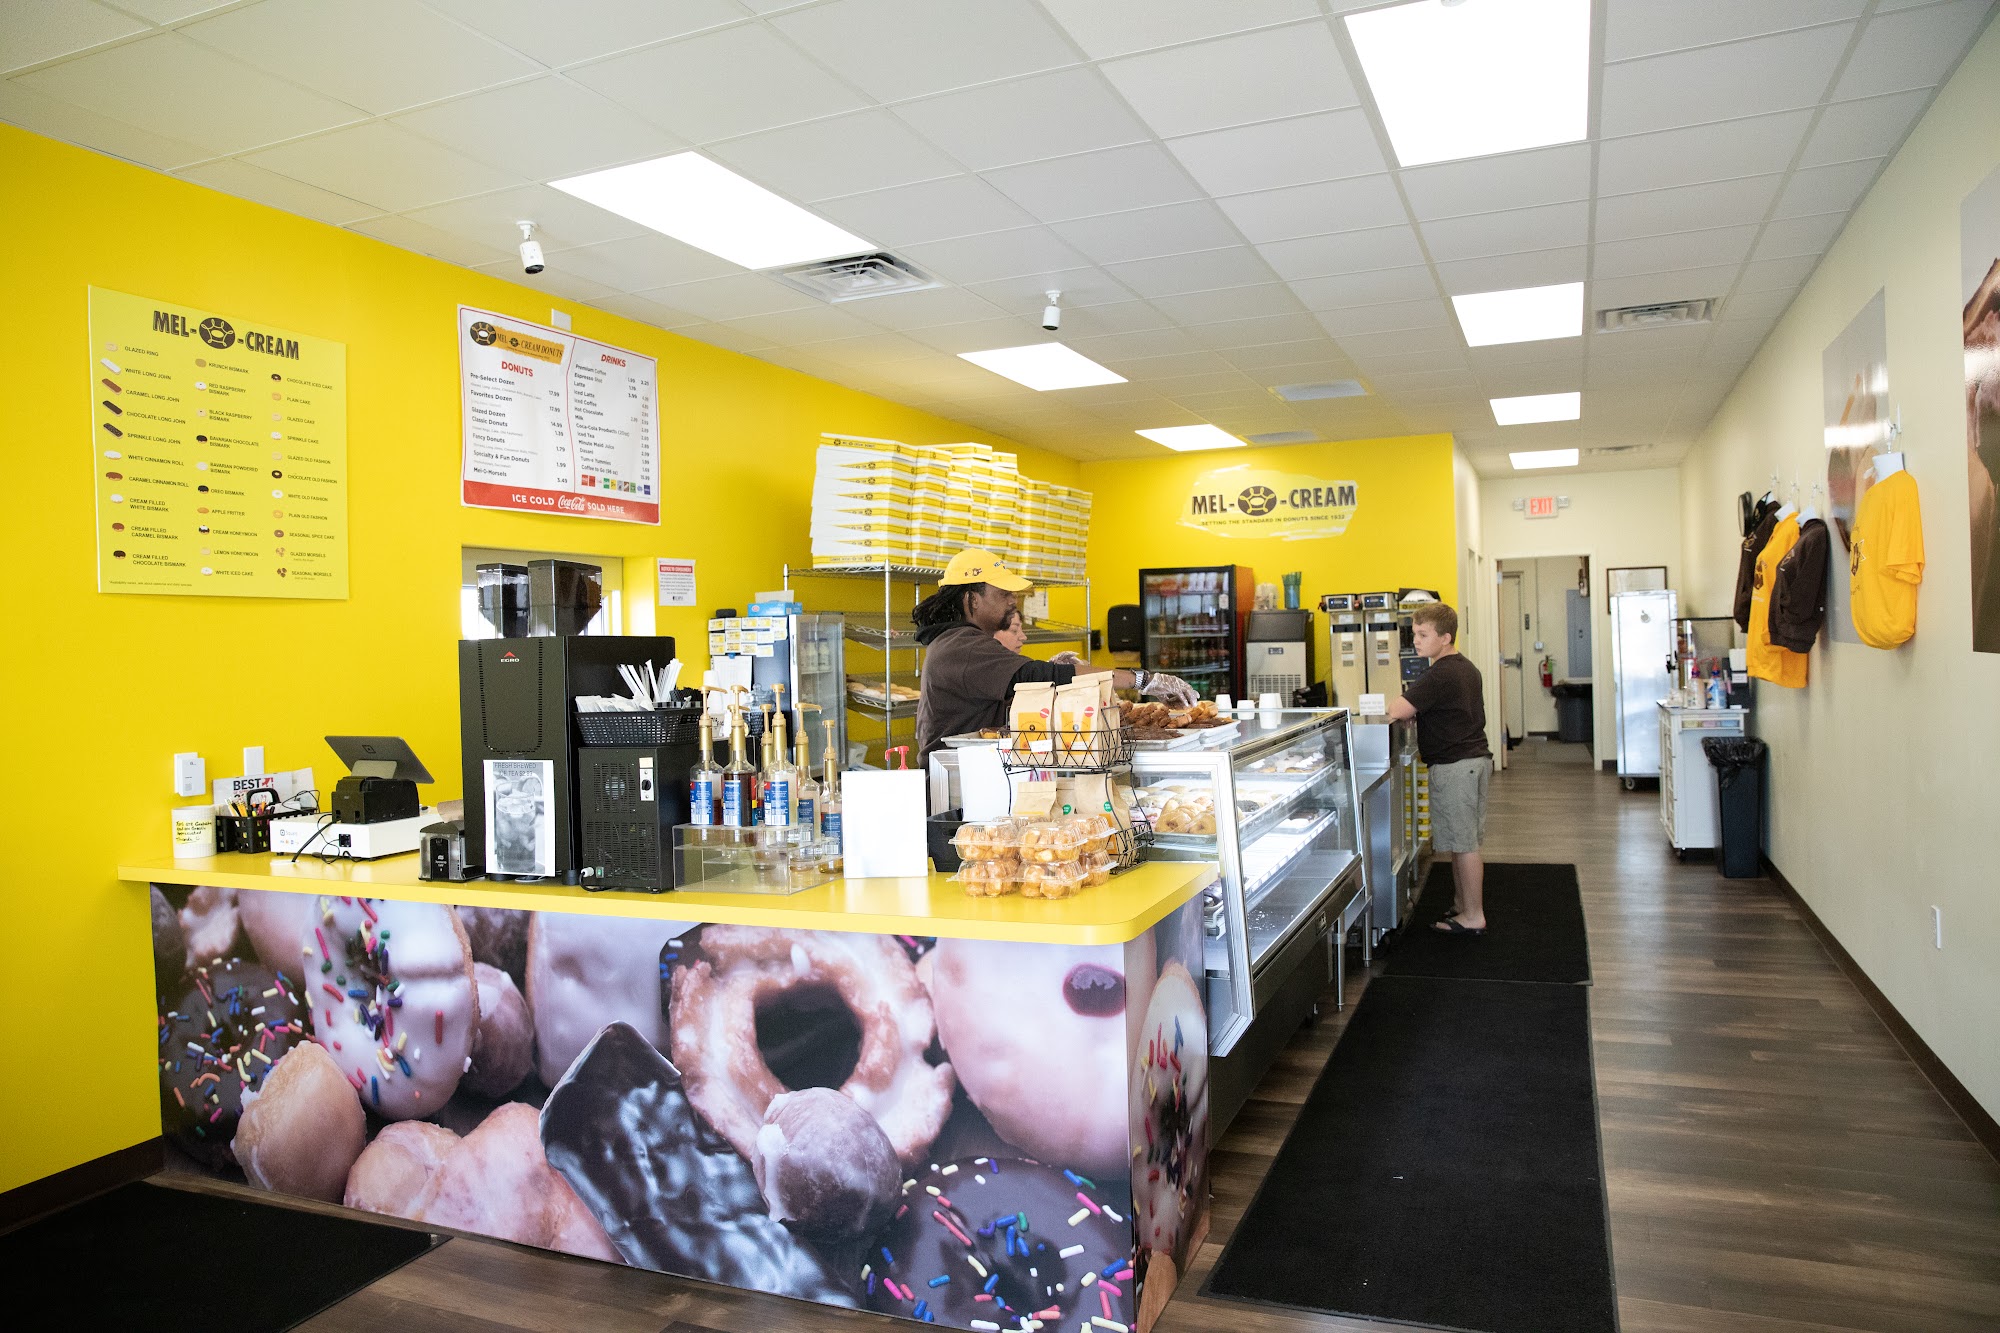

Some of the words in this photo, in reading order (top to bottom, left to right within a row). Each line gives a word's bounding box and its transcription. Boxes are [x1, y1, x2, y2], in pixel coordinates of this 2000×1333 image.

[125, 346, 145, 354] GLAZED
[521, 340, 540, 353] CREAM
[540, 345, 563, 358] DONUTS
[601, 354, 626, 367] DRINKS
[229, 366, 249, 374] BISMARK
[502, 361, 533, 377] DONUTS
[287, 377, 311, 386] CHOCOLATE
[470, 373, 497, 382] Pre-Select
[219, 385, 246, 393] RASPBERRY
[126, 389, 150, 398] CARAMEL
[151, 393, 165, 401] LONG
[471, 390, 493, 399] Favorites
[495, 394, 512, 402] Dozen
[126, 411, 157, 420] CHOCOLATE
[472, 407, 487, 415] Glazed
[226, 412, 252, 420] RASPBERRY
[472, 416, 487, 424] Classic
[489, 419, 508, 427] Donuts
[576, 423, 597, 431] Coca-Cola
[127, 432, 151, 440] SPRINKLE
[287, 435, 307, 443] SPRINKLE
[473, 433, 485, 441] Fancy
[474, 450, 494, 459] Specialty
[512, 494, 527, 503] ICE
[530, 496, 554, 506] COLD
[587, 502, 605, 511] SOLD
[607, 505, 625, 514] HERE
[1530, 497, 1553, 514] EXIT
[233, 778, 261, 791] BEST
